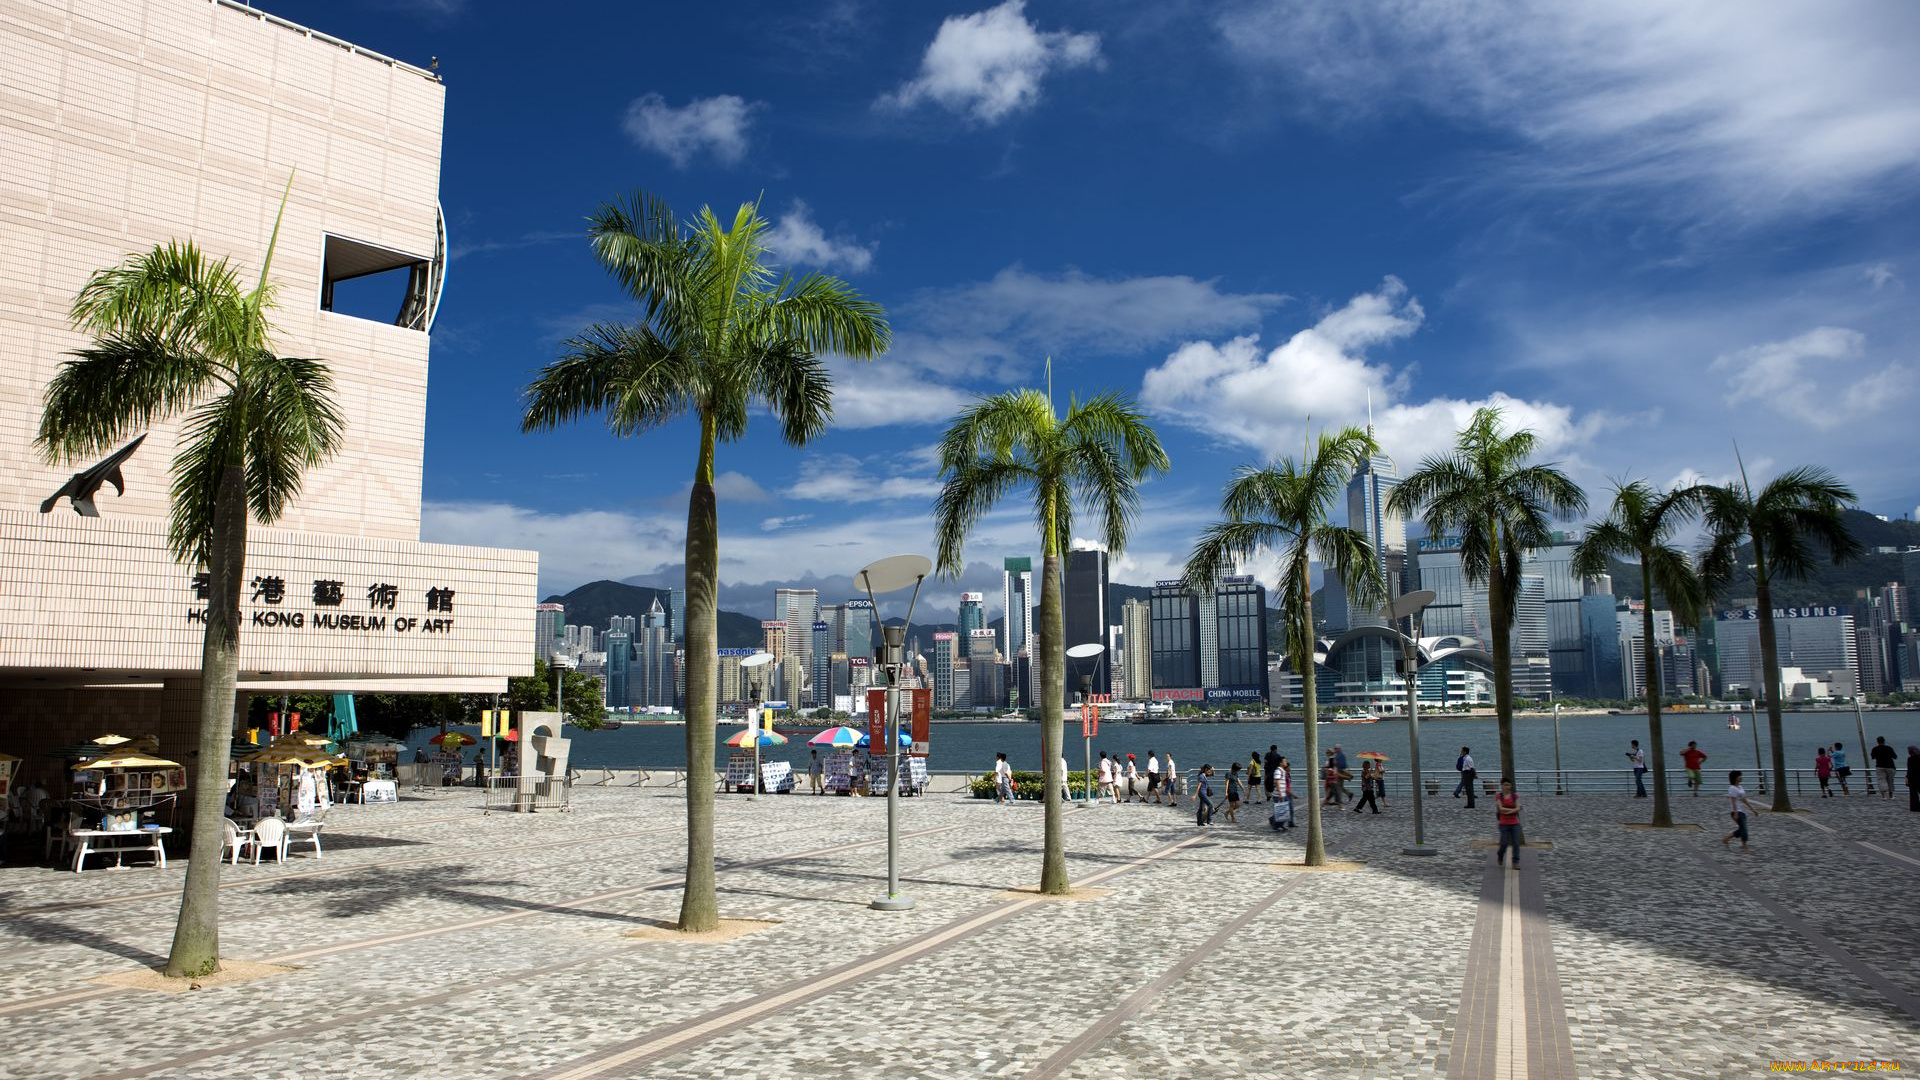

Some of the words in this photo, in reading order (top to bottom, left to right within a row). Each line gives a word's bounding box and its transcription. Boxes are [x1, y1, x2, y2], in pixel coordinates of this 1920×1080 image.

[849, 600, 873, 608] EPSON
[1748, 606, 1837, 620] SMSUNG
[252, 611, 304, 629] KONG
[312, 613, 386, 631] MUSEUM
[393, 616, 417, 632] OF
[421, 619, 454, 634] ART
[718, 647, 756, 656] nasonic
[1152, 689, 1204, 699] HITACHI
[1208, 690, 1231, 698] CHINA
[1233, 689, 1261, 697] MOBILE
